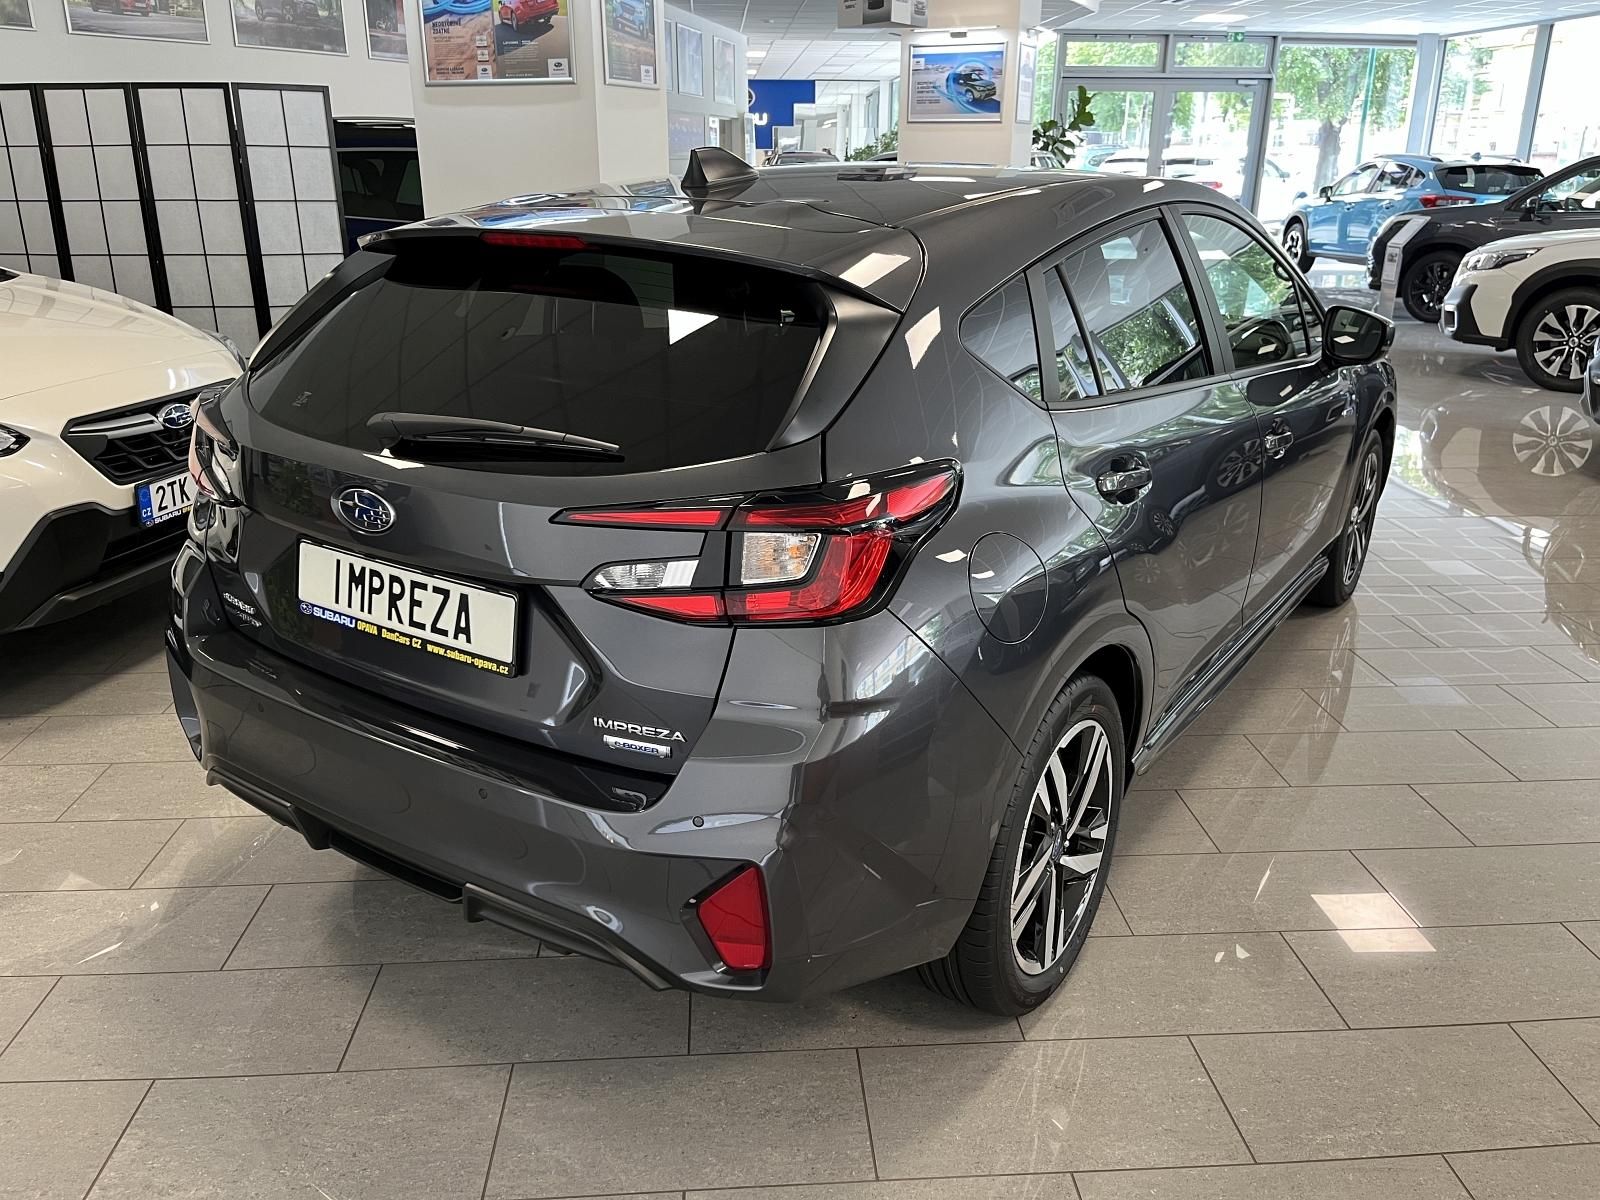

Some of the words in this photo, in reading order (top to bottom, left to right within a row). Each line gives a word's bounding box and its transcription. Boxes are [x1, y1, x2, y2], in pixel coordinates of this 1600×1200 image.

[155, 476, 191, 512] 2TK
[142, 507, 152, 518] CZ
[154, 510, 182, 524] SUBARU
[334, 559, 472, 644] IMPREZA
[312, 606, 355, 628] SUBARU
[356, 620, 378, 635] OPAVA
[381, 628, 410, 645] DanCars
[411, 638, 422, 649] CZ
[426, 643, 509, 675] www.subaru-opava.cz
[592, 716, 687, 743] IMPREZA
[614, 740, 659, 754] e-BOXER
